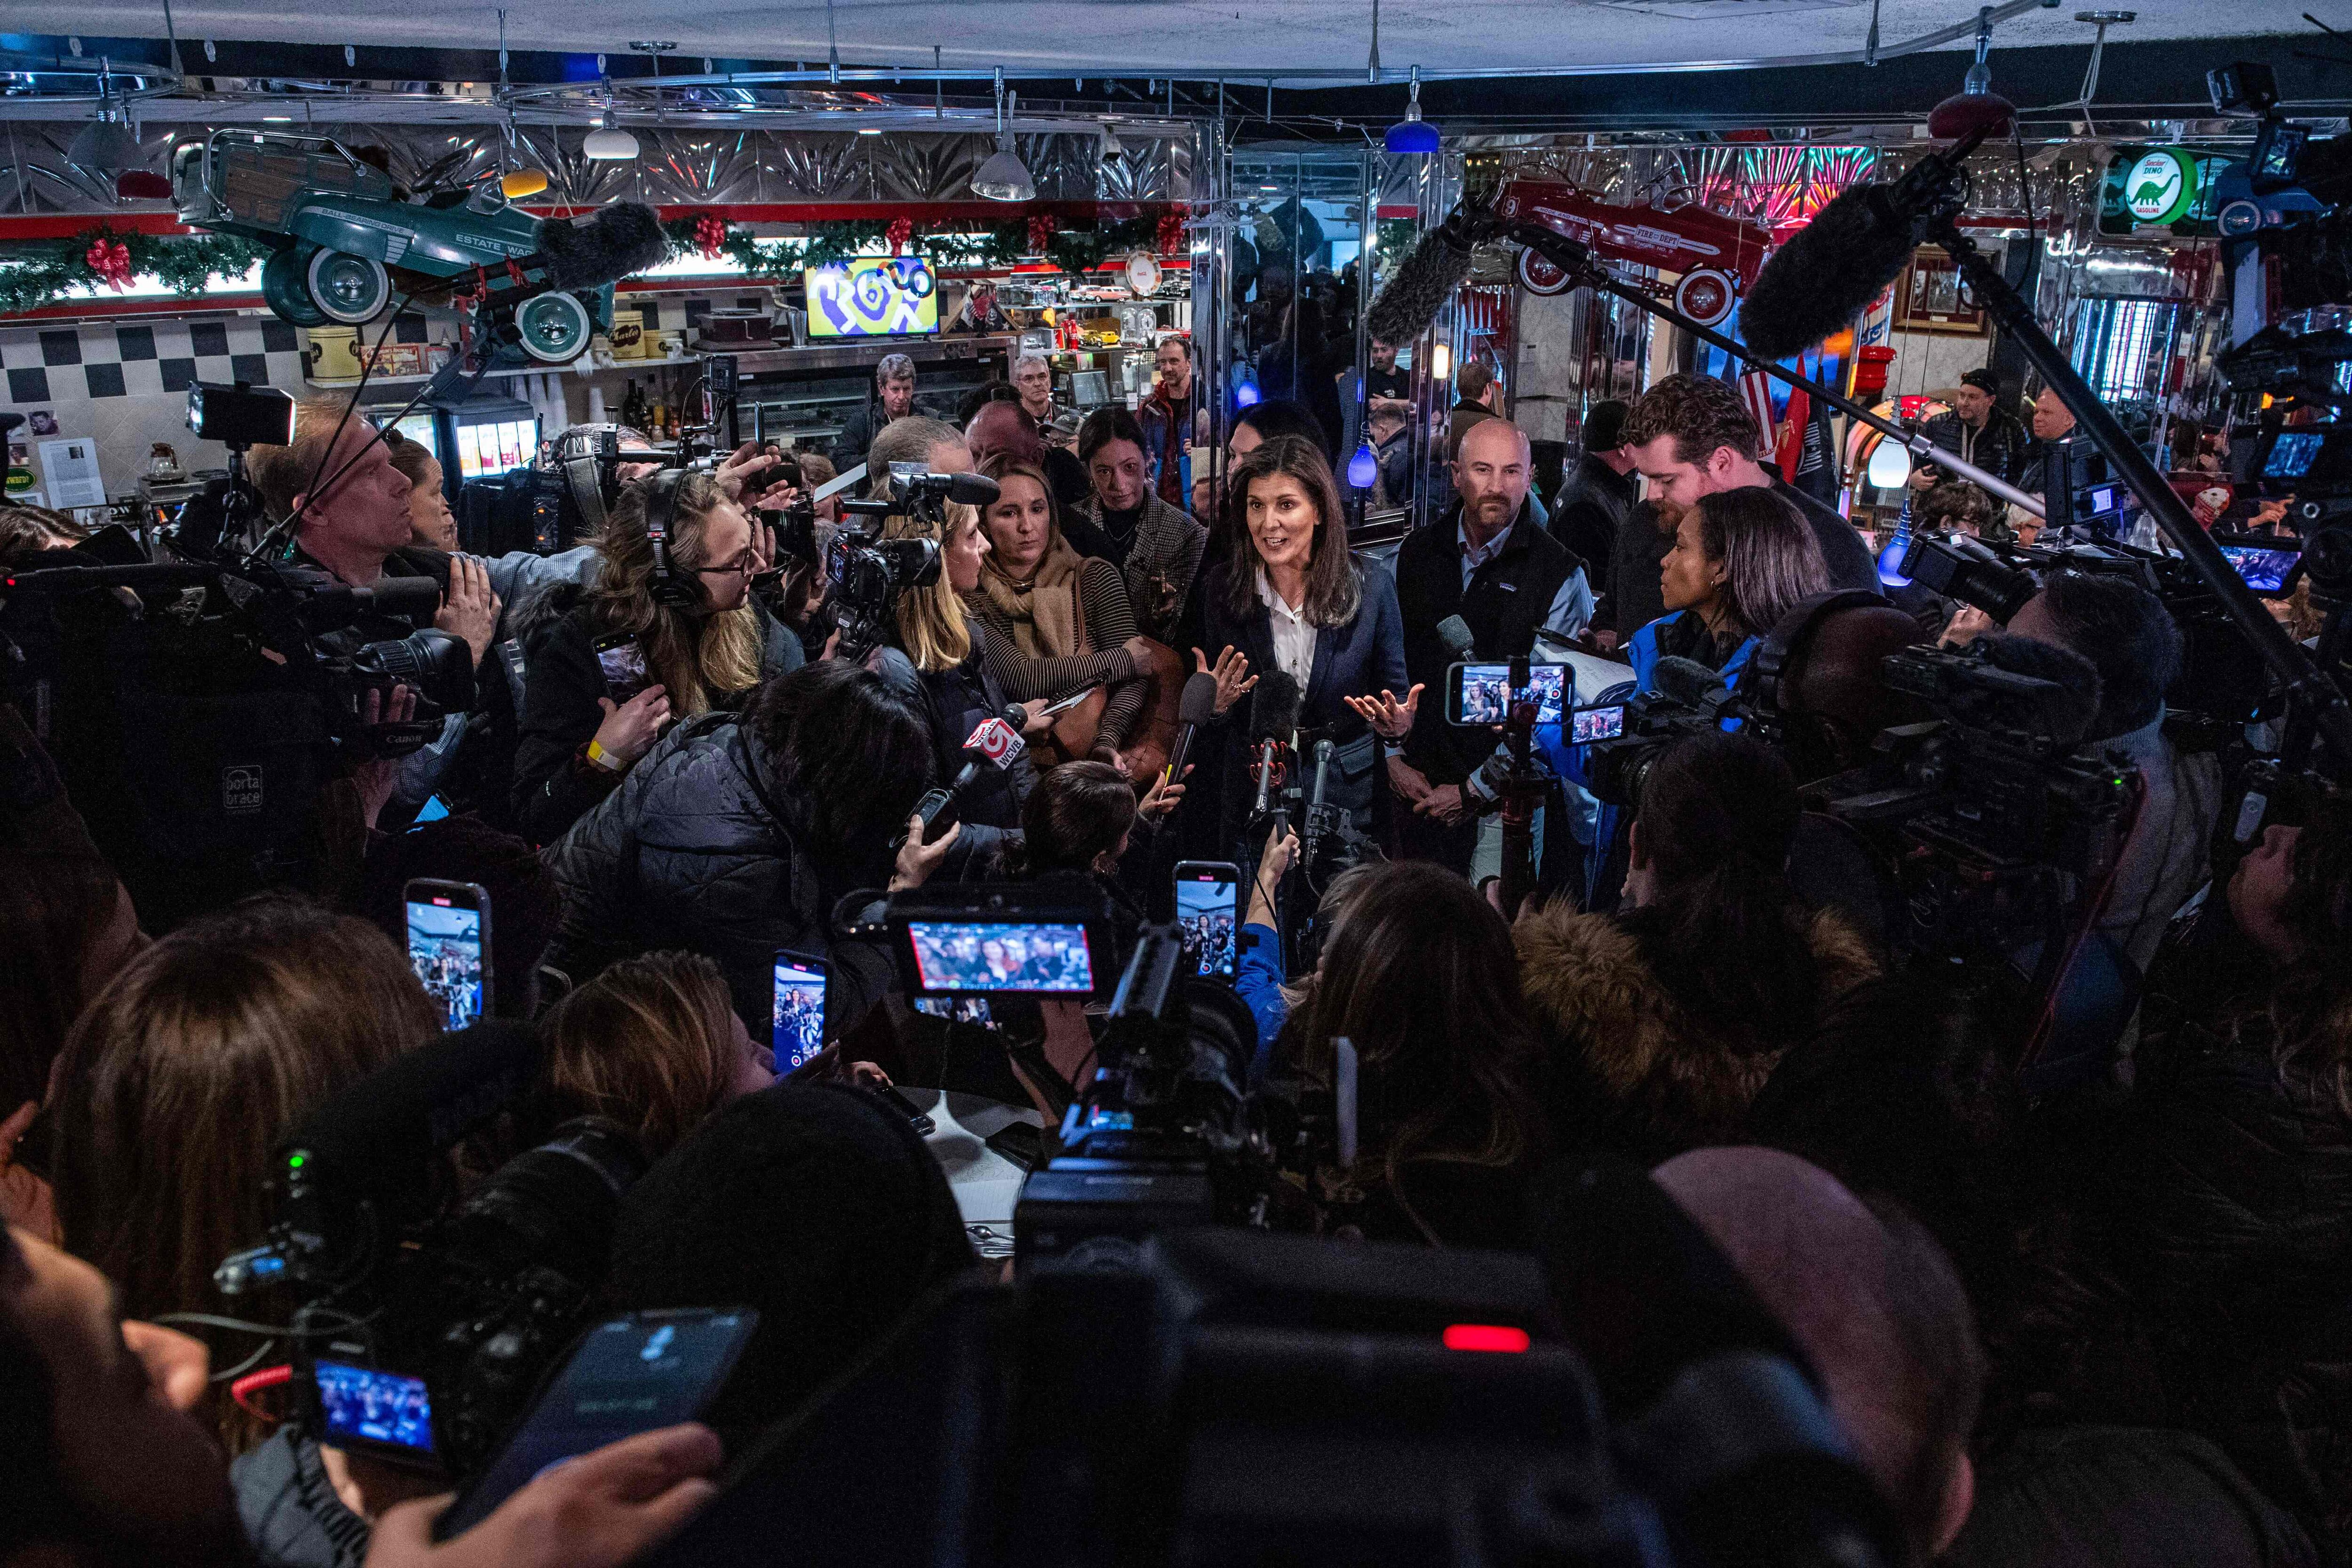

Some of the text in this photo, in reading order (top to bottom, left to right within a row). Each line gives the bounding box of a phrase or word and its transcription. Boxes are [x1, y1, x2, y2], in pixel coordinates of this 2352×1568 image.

[1506, 199, 1516, 215] 9
[322, 209, 405, 233] BALL BEARING DRIVE
[456, 234, 501, 251] ESTATE
[1637, 229, 1677, 245] FIRE DEPT
[386, 734, 422, 743] Canon
[999, 740, 1022, 766] WCVB
